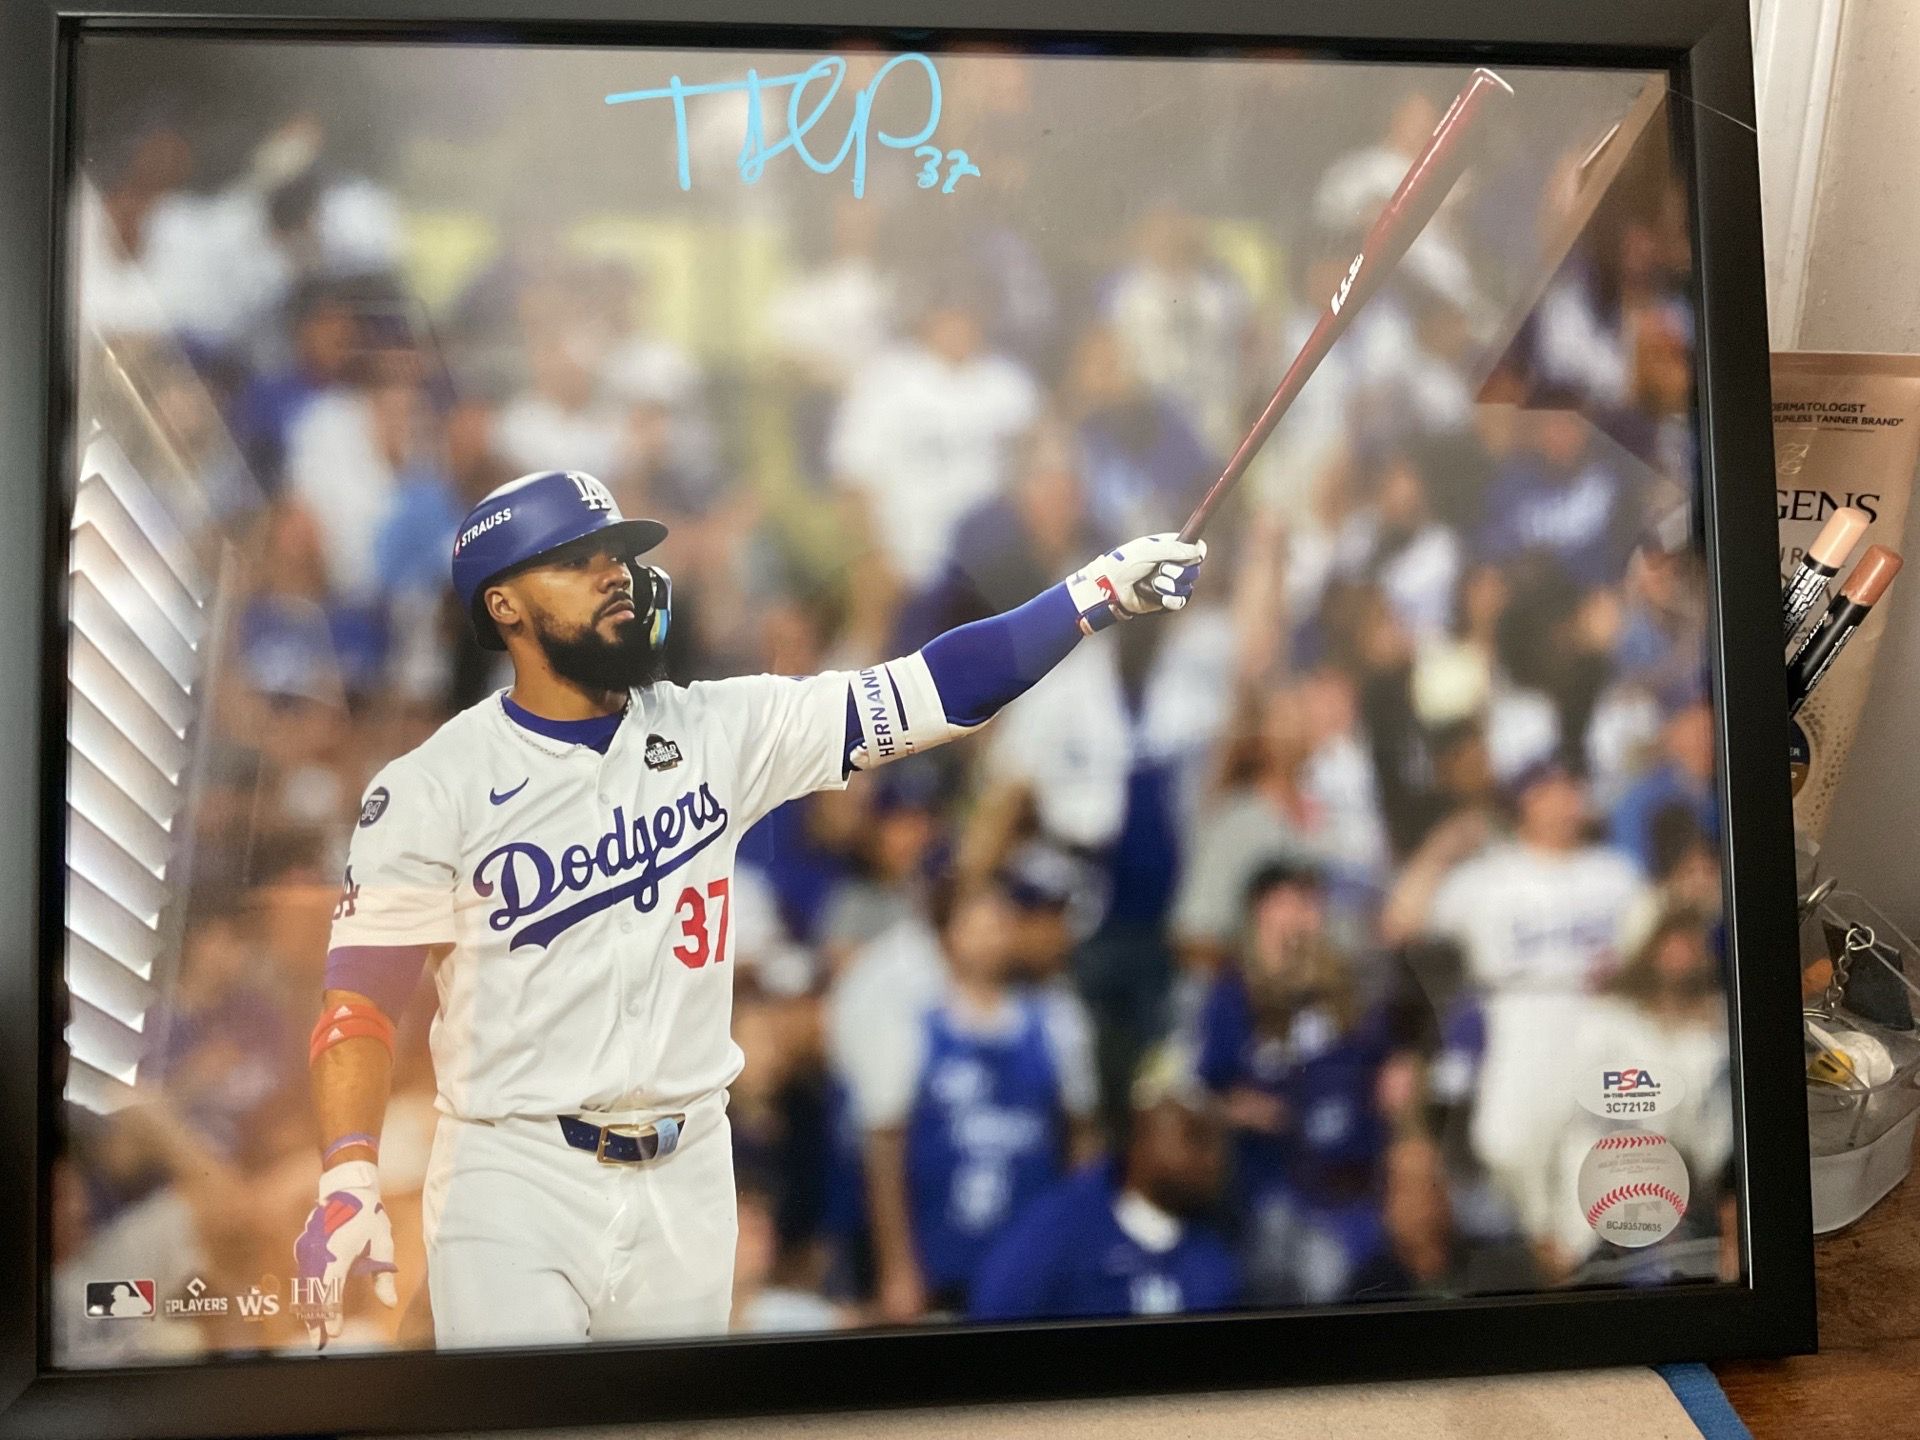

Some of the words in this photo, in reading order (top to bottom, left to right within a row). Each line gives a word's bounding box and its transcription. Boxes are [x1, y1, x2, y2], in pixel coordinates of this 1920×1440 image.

[1816, 415, 1858, 425] TANNER
[567, 473, 610, 510] LA
[461, 507, 512, 547] STRAUSS
[646, 744, 677, 759] WORLD
[473, 781, 728, 932] Dodgers
[673, 877, 729, 969] 37
[1603, 1068, 1656, 1091] PSA
[1605, 1101, 1656, 1114] 3C72128
[171, 1297, 228, 1313] PLAYERS
[235, 1294, 280, 1317] WS
